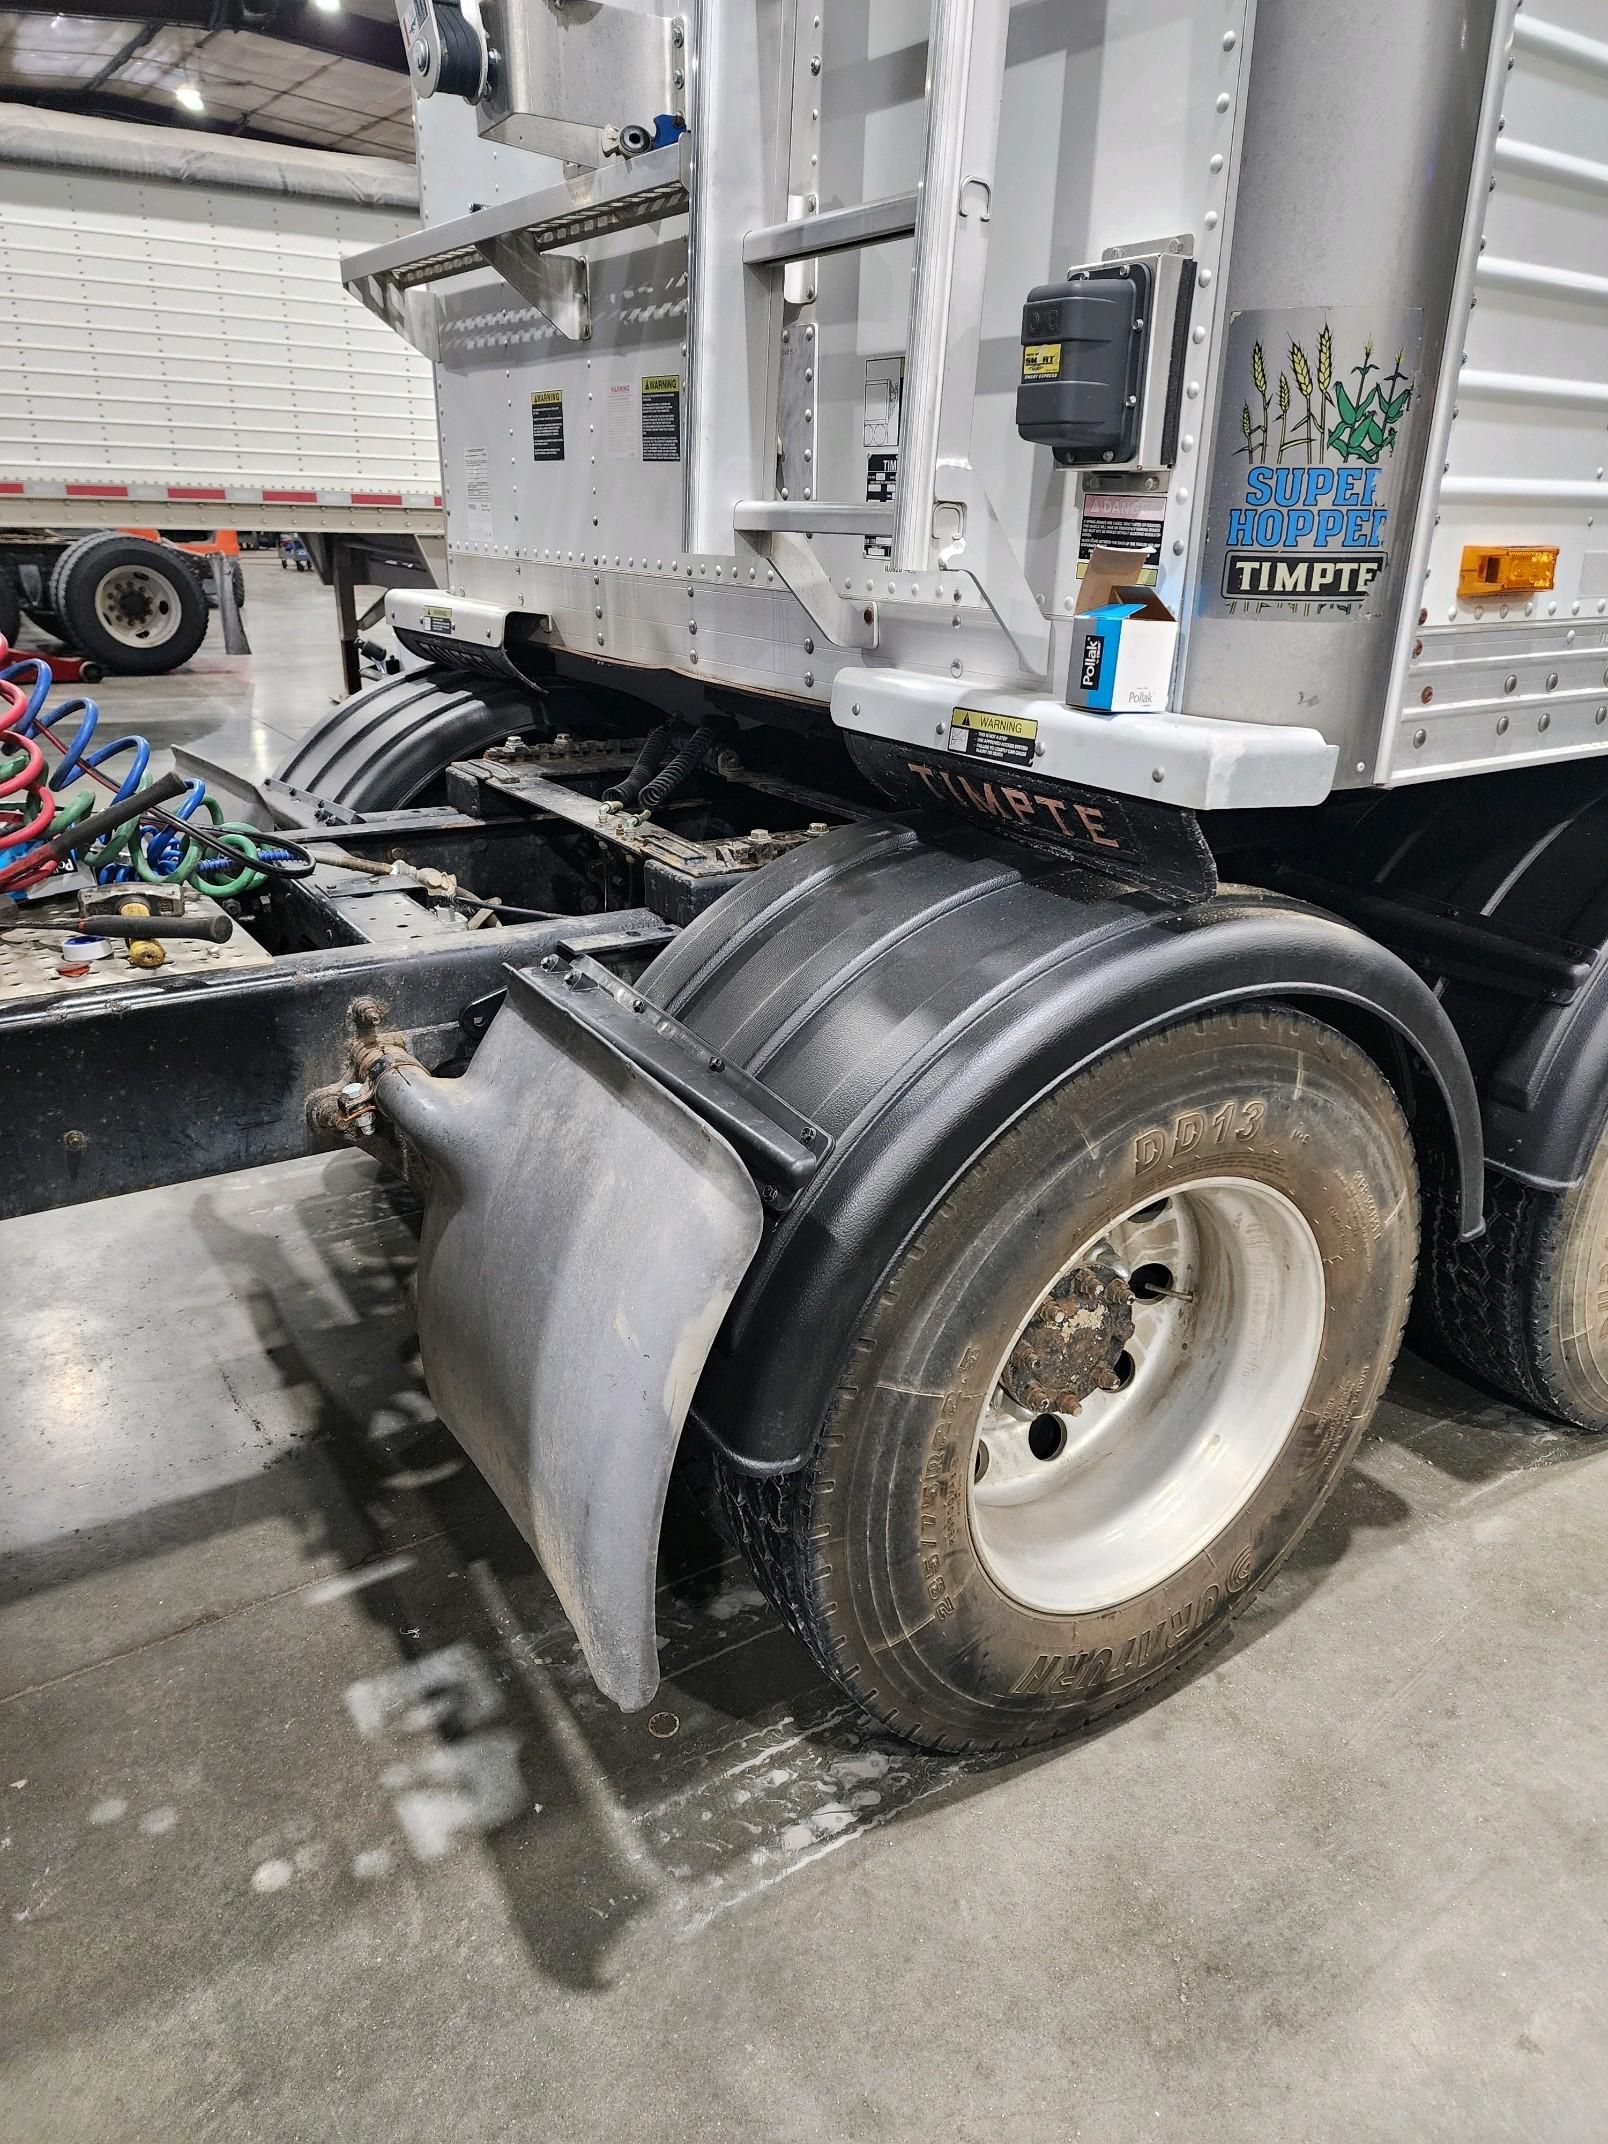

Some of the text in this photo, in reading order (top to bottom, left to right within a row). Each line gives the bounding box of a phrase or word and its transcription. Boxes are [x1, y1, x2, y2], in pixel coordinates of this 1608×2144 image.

[650, 379, 677, 391] WARNING
[537, 392, 560, 402] WARNING
[883, 460, 897, 472] TIM
[1103, 498, 1157, 515] DANG
[1235, 561, 1379, 592] TIMPTE
[1082, 639, 1100, 687] Pollak
[1128, 691, 1153, 704] Pollak
[980, 715, 1023, 734] WARNING
[907, 762, 1120, 848] TIMPTE
[1134, 1100, 1265, 1176] DD13
[1010, 1545, 1251, 1694] DURATURN
